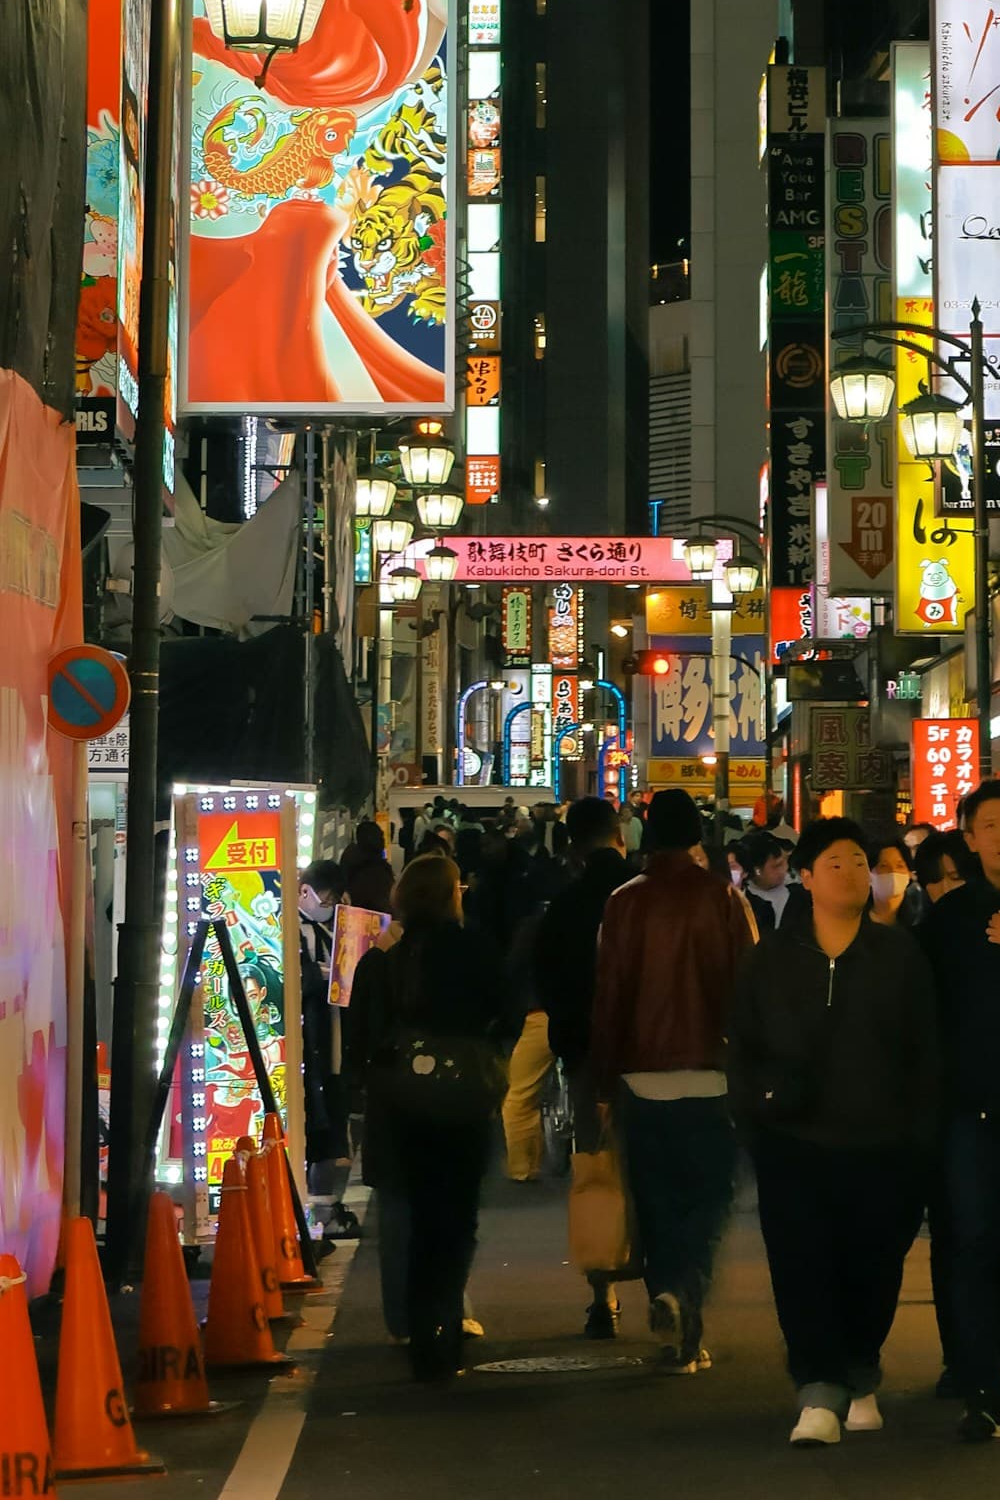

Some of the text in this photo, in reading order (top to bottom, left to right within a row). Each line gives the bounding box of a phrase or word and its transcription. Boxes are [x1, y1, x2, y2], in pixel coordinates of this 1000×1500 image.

[775, 209, 821, 226] AMG
[857, 501, 887, 528] 20
[859, 530, 885, 551] m
[467, 541, 643, 563] 歌舞伎町 さくら通り
[466, 565, 651, 577] Kabukicho Sakura-dori St.
[927, 726, 950, 742] 5F
[955, 726, 974, 796] カラオケ
[930, 784, 949, 817] 千円
[227, 842, 270, 866] 受付
